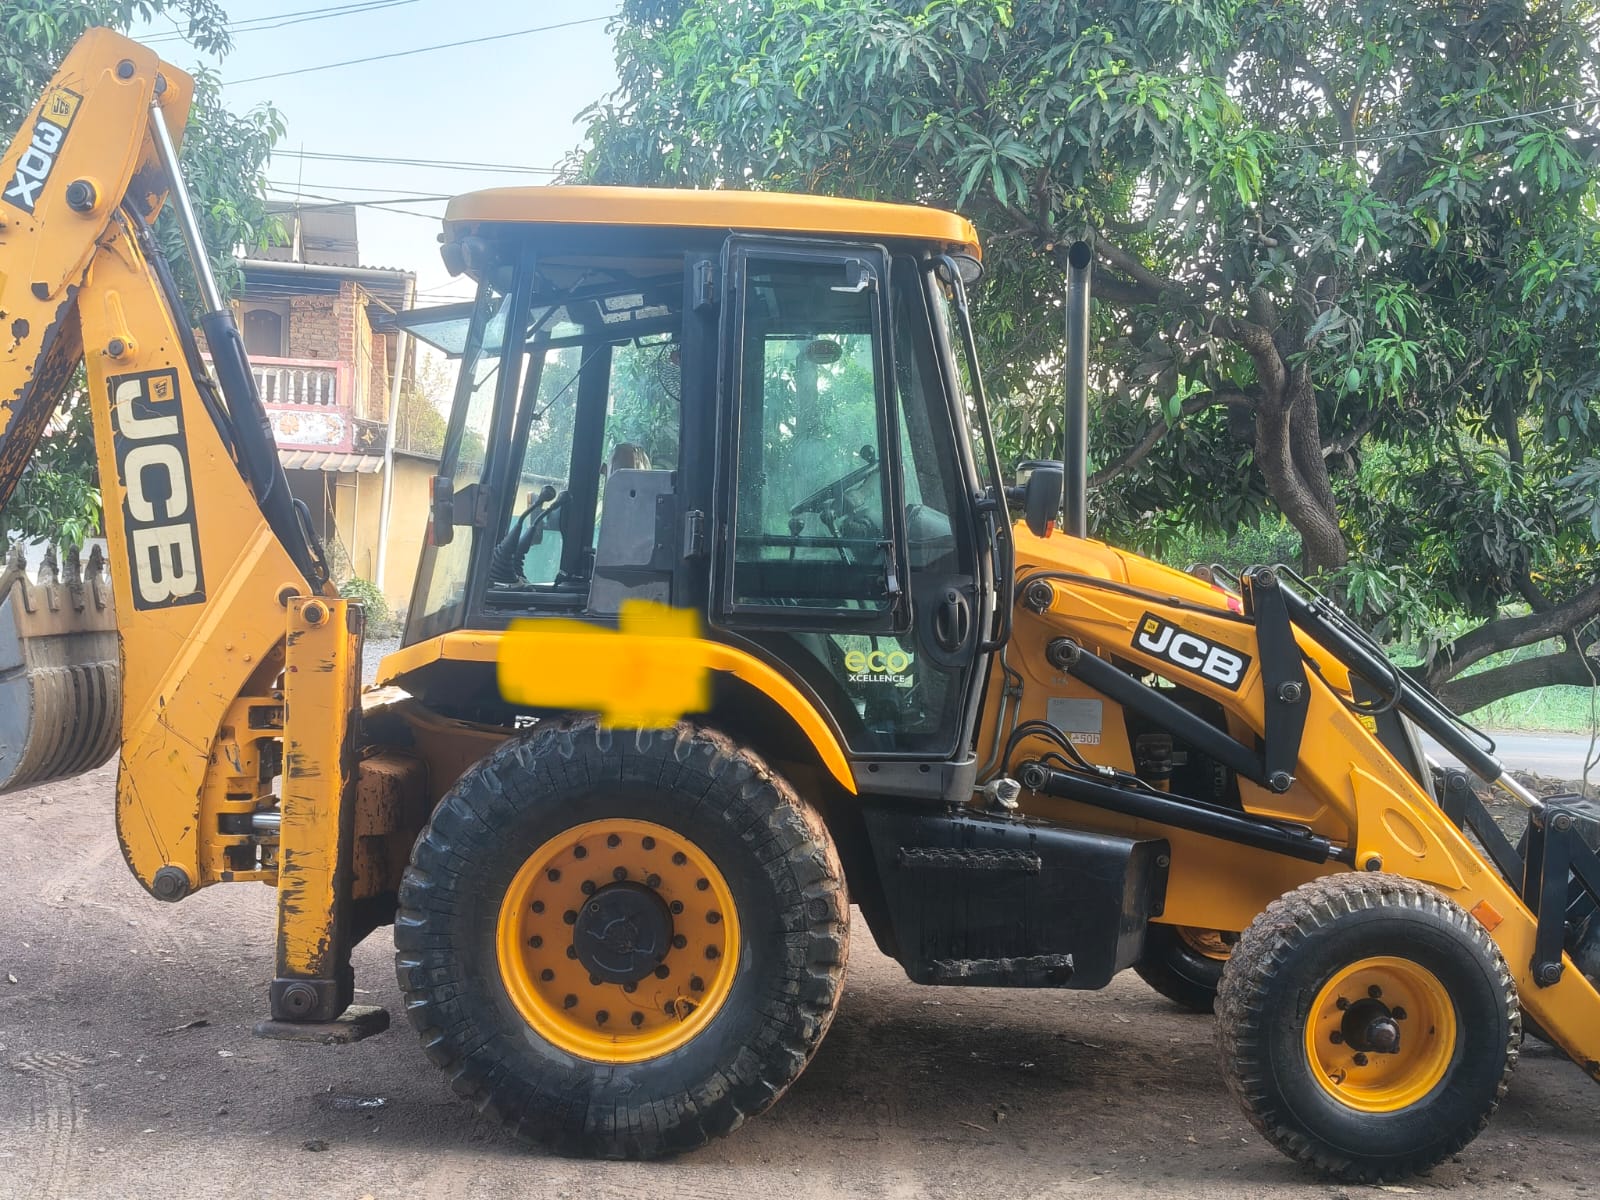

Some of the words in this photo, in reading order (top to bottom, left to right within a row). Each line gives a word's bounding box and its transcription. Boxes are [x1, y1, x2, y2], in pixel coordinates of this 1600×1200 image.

[5, 121, 63, 208] 3DX
[116, 379, 198, 603] JCB
[844, 650, 909, 672] eco
[848, 674, 905, 683] XCELLENCE
[1138, 626, 1243, 684] JCB
